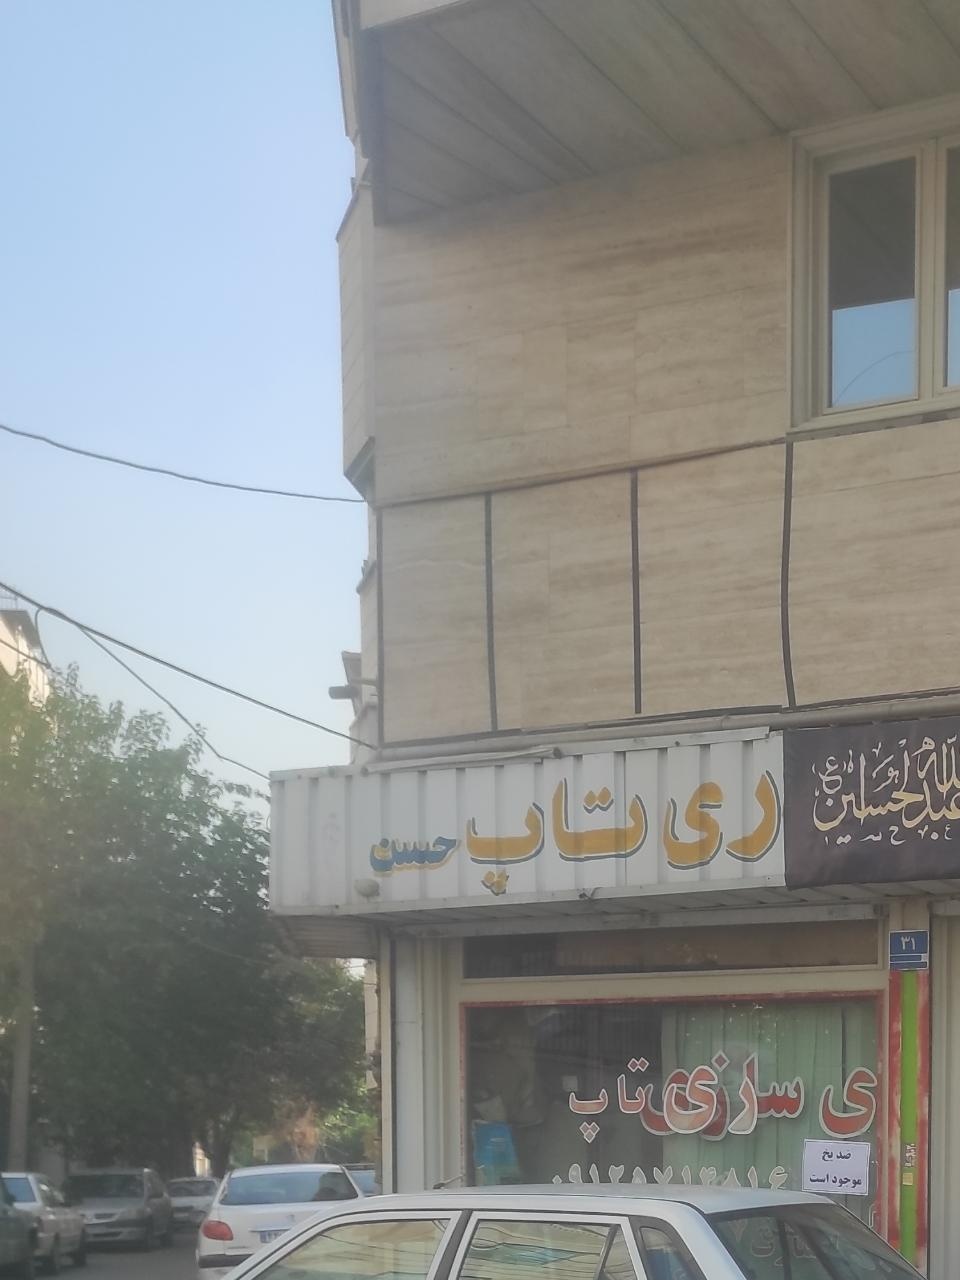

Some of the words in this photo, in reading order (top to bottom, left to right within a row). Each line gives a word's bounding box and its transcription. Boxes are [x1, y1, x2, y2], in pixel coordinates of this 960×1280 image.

[368, 833, 461, 874] حسن
[465, 776, 648, 897] تاپ
[568, 1056, 649, 1144] تاپ
[662, 1050, 805, 1136] سازی
